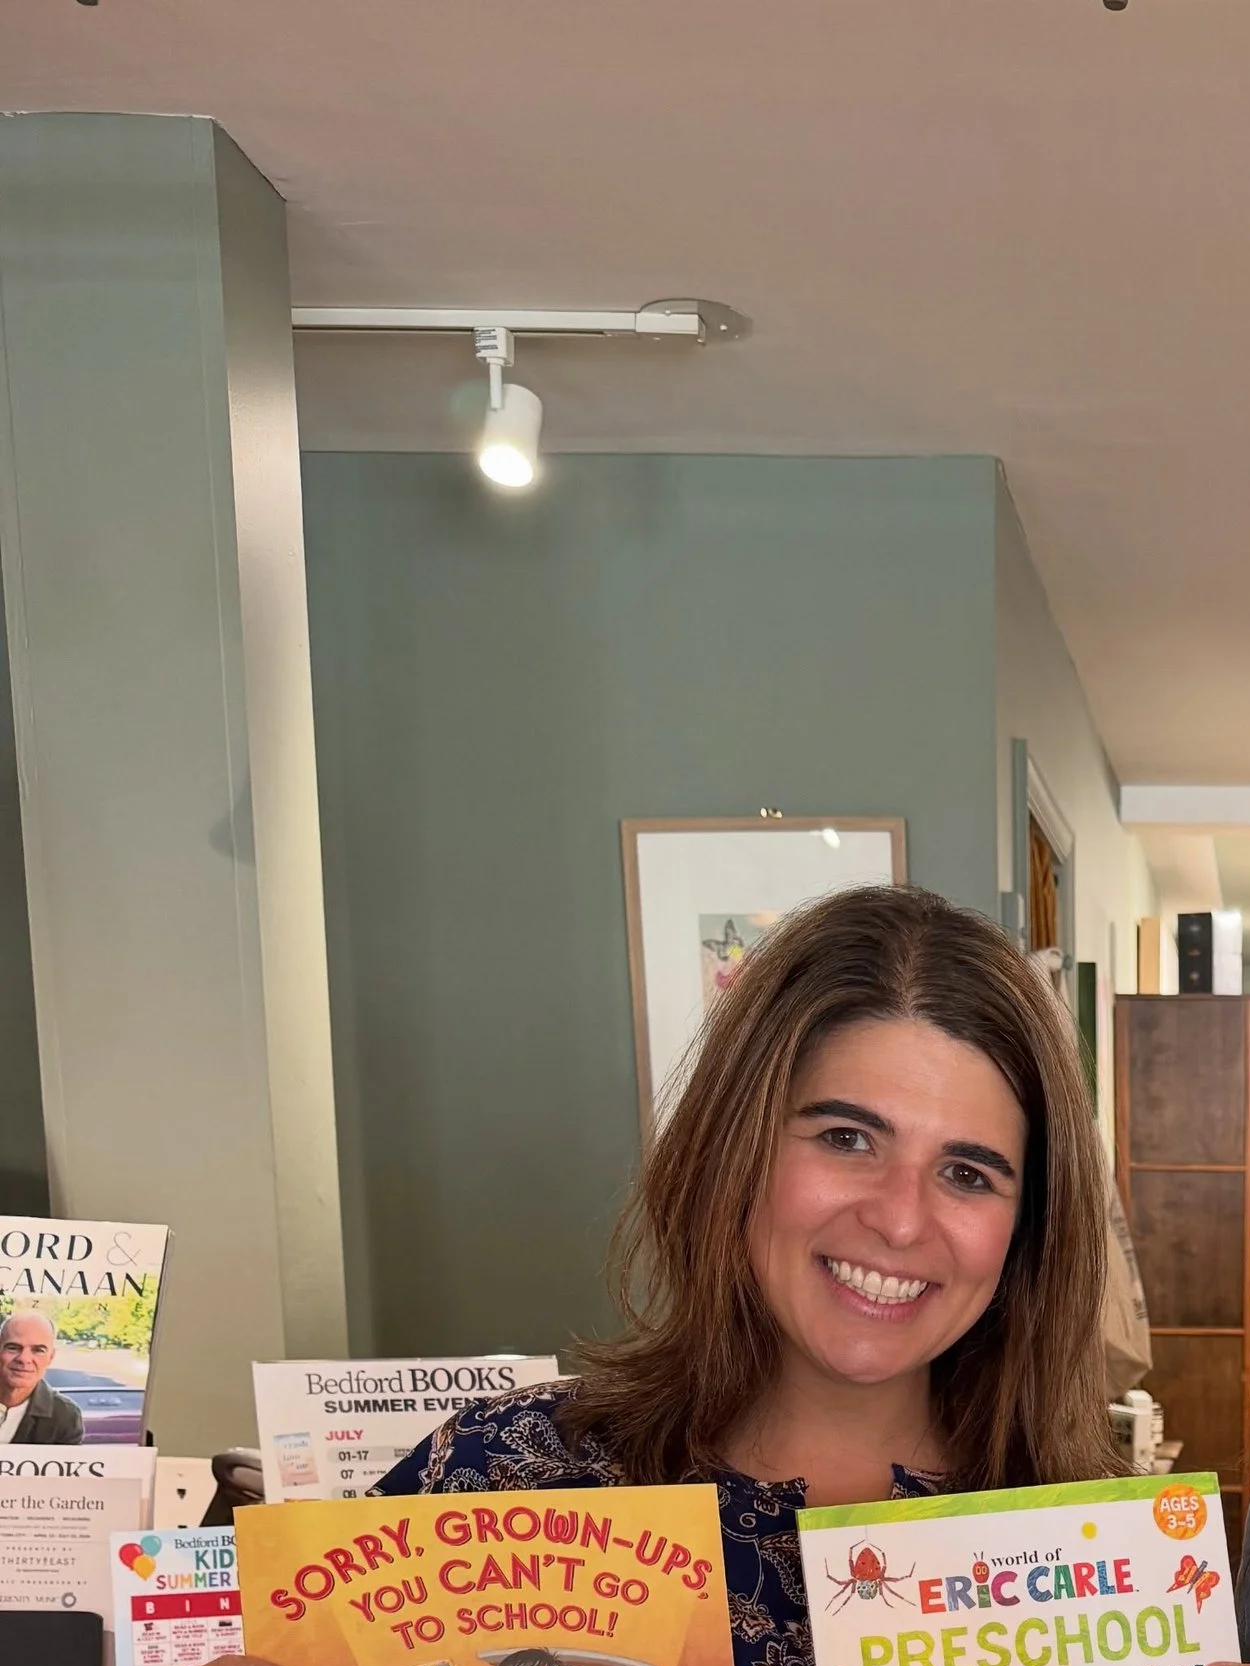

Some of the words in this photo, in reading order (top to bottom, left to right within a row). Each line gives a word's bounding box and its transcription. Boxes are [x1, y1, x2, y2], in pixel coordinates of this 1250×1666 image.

[1, 1230, 93, 1262] ORD
[106, 1231, 141, 1266] &
[305, 1370, 403, 1396] Bedford
[408, 1366, 516, 1393] BOOKS
[324, 1399, 417, 1413] SUMMER
[325, 1430, 364, 1441] JULY
[338, 1450, 369, 1461] 01-17
[340, 1469, 354, 1480] 07
[21, 1495, 45, 1510] the
[50, 1496, 104, 1511] Garden
[1159, 1495, 1200, 1513] AGES
[1167, 1513, 1196, 1530] 3-5
[174, 1536, 219, 1549] Bedford
[270, 1518, 425, 1622] SORRY,
[434, 1506, 713, 1600] GROWN-UPS,
[991, 1551, 1038, 1568] world
[1044, 1548, 1062, 1563] of
[156, 1571, 231, 1589] SUMMER
[349, 1575, 429, 1624] YOU
[438, 1553, 585, 1596] CAN'T
[593, 1571, 650, 1607] GO
[918, 1571, 1021, 1615] ERIC
[1027, 1558, 1135, 1603] CARLE
[391, 1615, 445, 1650] TO
[457, 1603, 619, 1638] SCHOOL!
